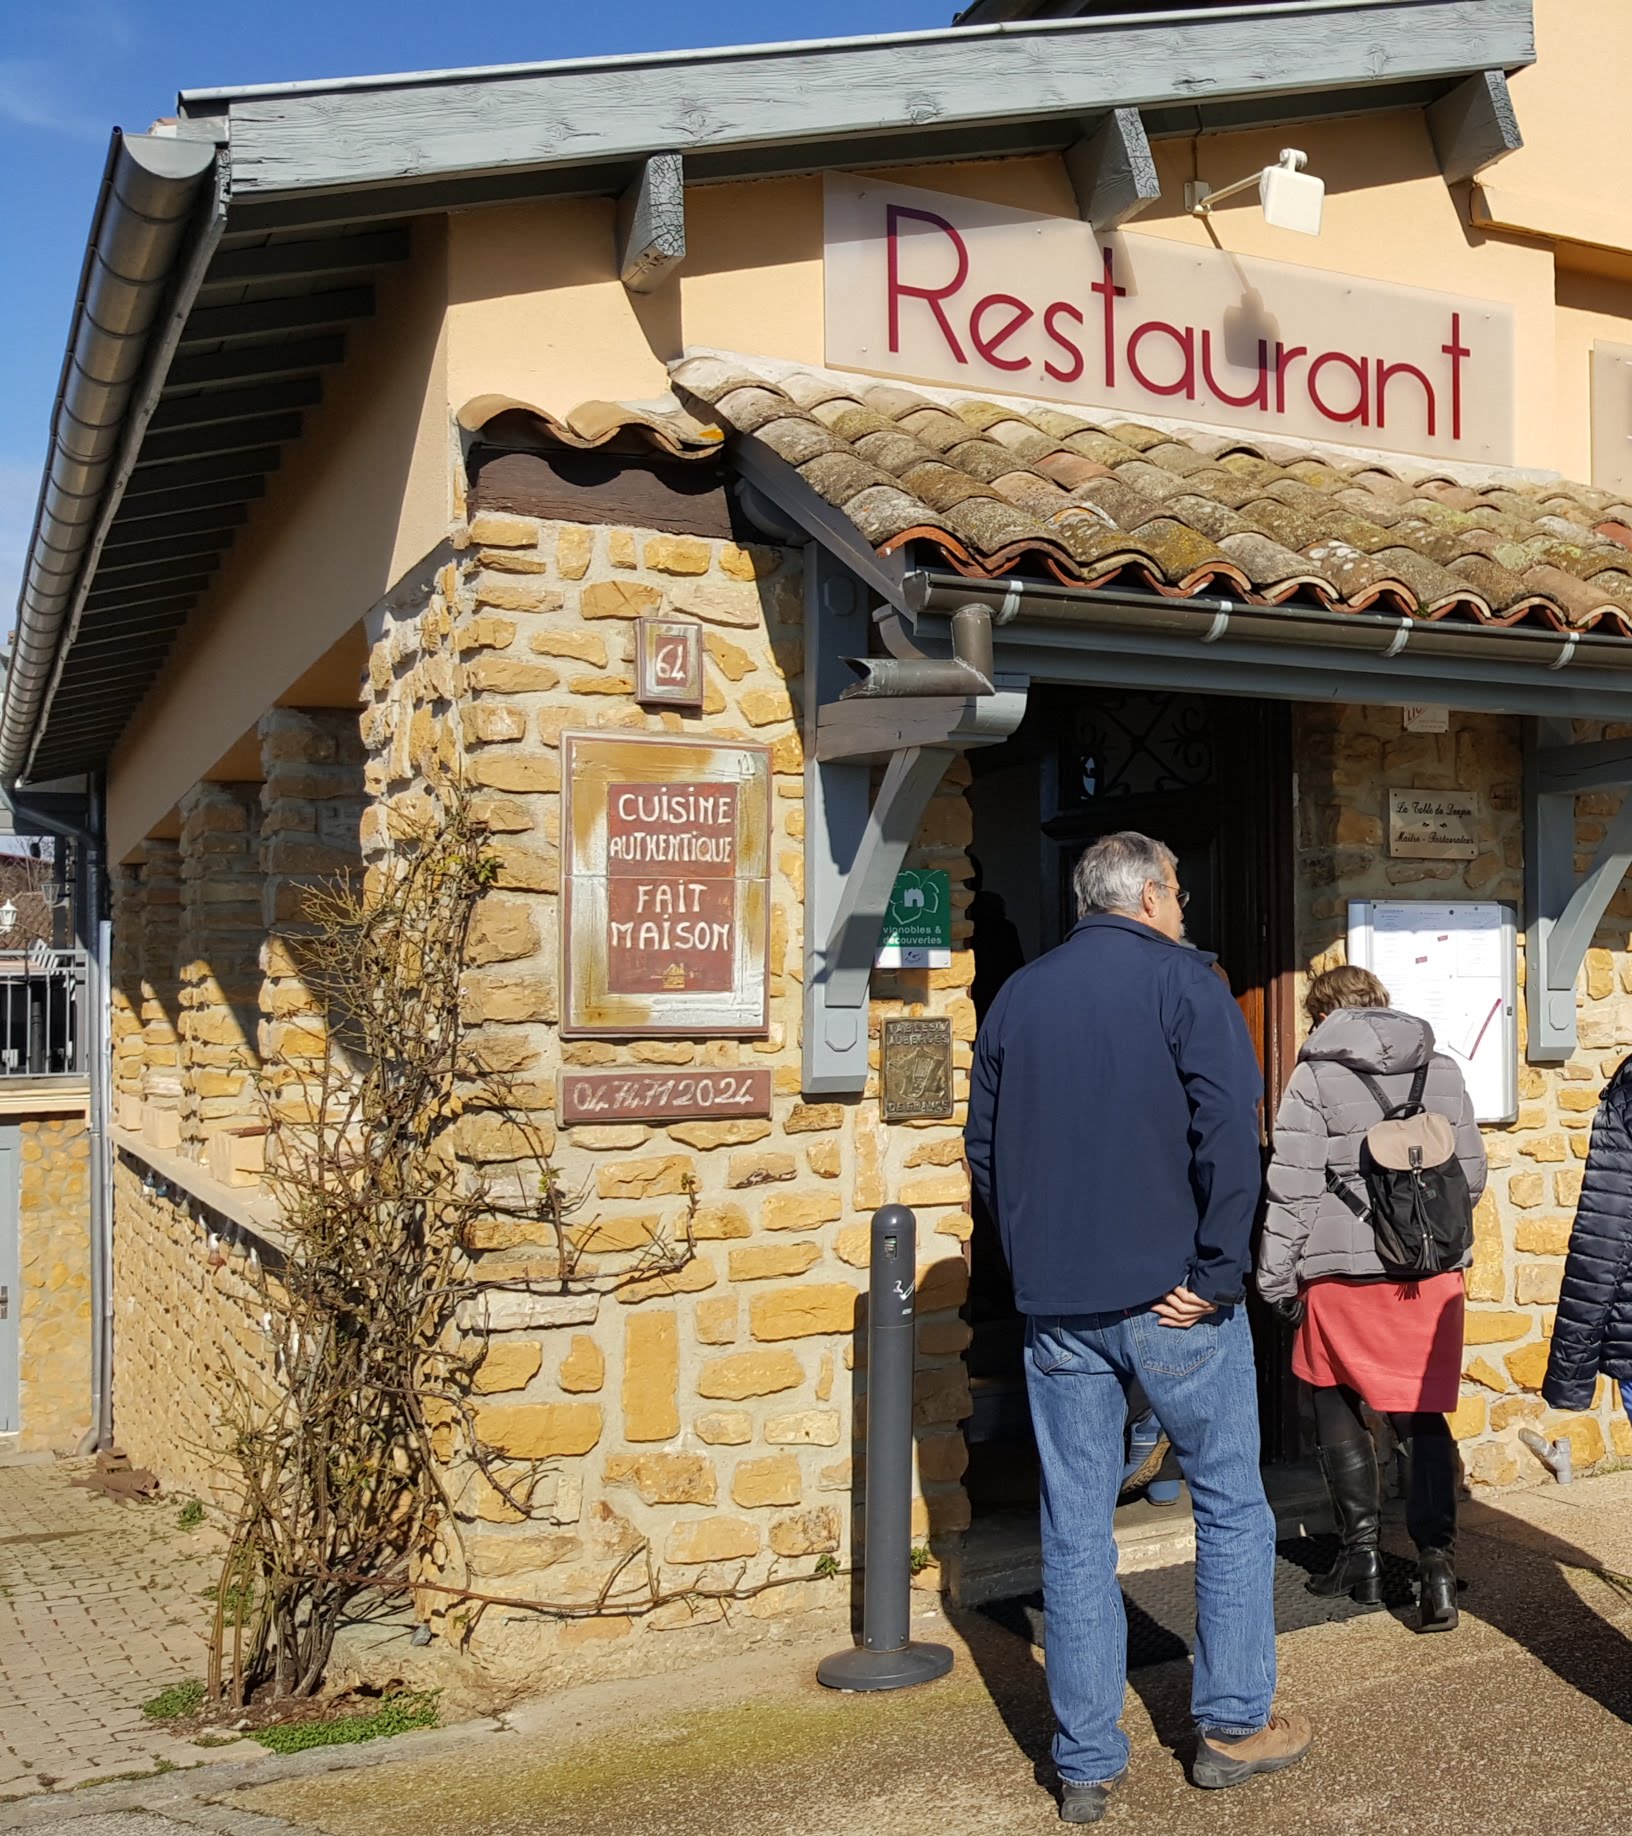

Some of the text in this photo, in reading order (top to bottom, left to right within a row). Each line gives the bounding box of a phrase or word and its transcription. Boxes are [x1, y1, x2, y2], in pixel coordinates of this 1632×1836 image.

[886, 203, 1471, 441] Restaurant
[656, 644, 686, 681] 64
[610, 831, 732, 863] AUTHENTIQUE
[637, 880, 708, 913] FAIT
[611, 914, 731, 951] MAISON
[882, 925, 932, 937] vignobles
[888, 1033, 950, 1046] AUBERGES
[888, 1100, 950, 1113] DE FRANCE
